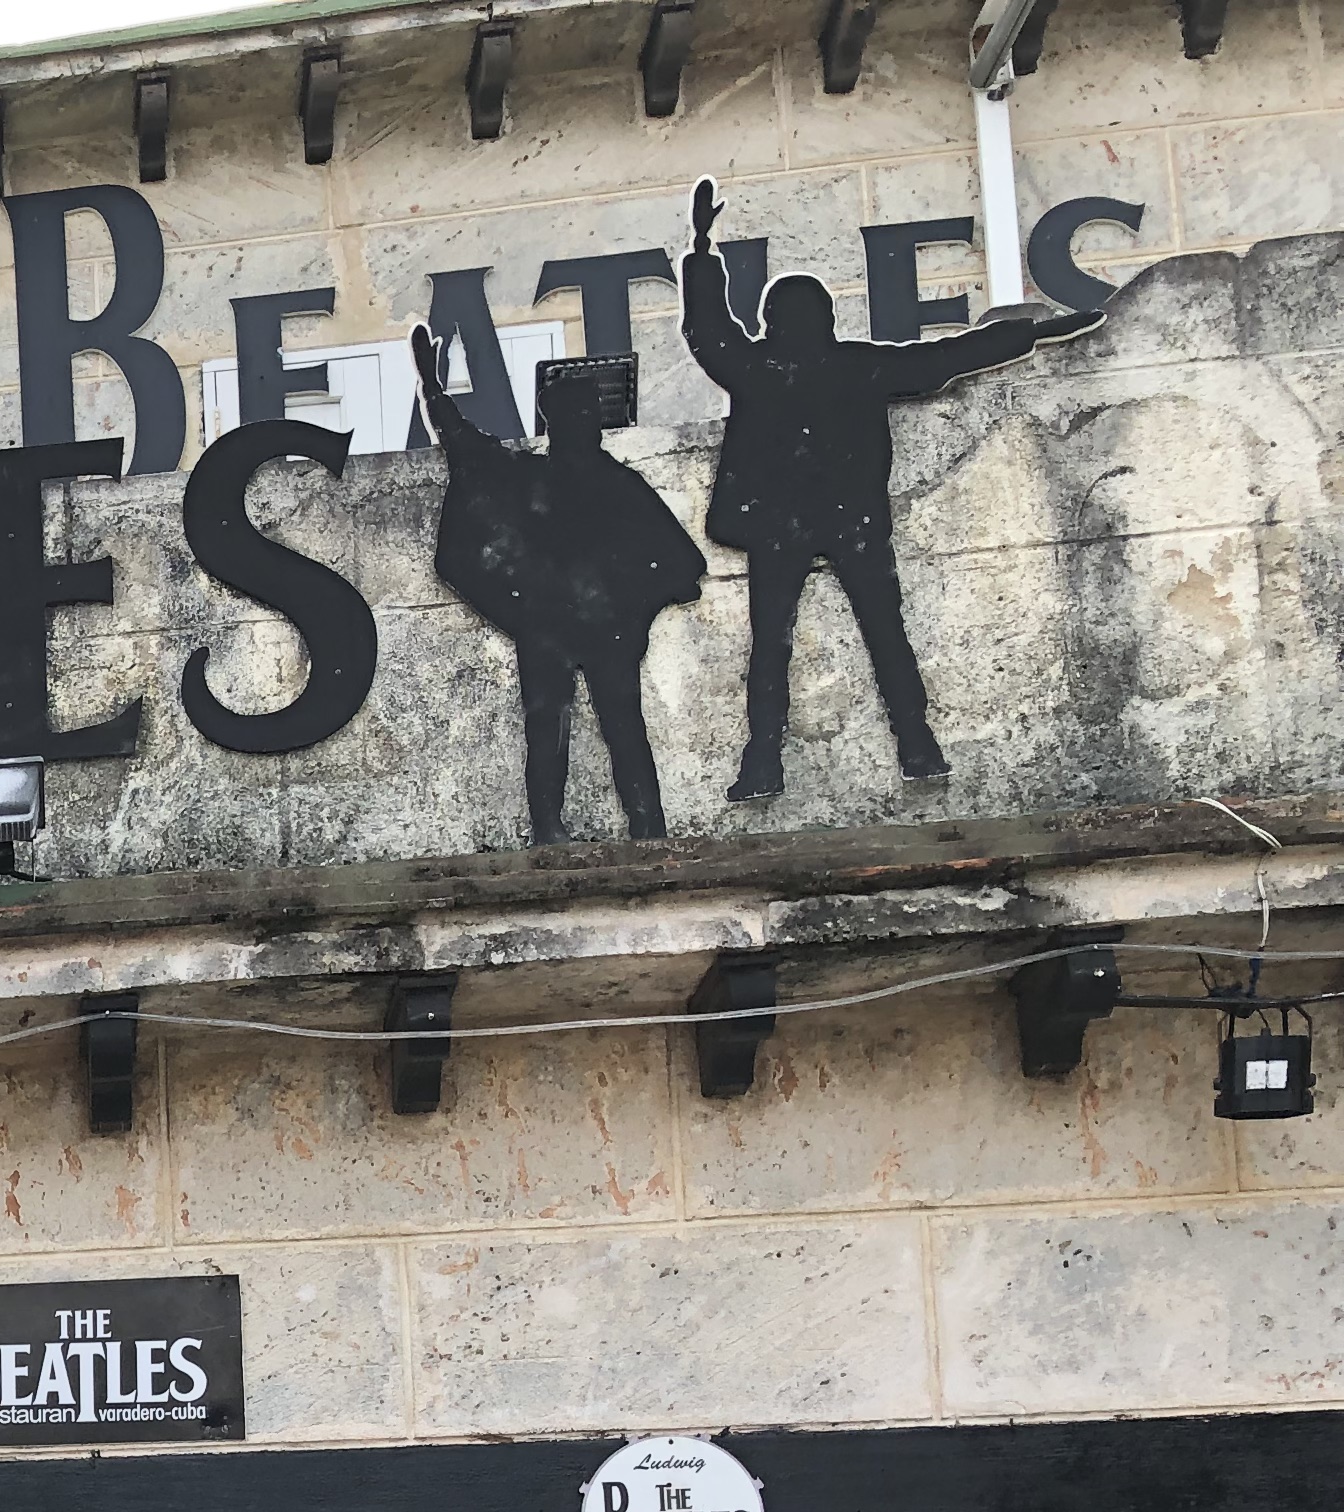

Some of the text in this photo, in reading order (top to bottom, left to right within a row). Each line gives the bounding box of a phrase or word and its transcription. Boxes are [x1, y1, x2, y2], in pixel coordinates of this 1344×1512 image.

[55, 1309, 112, 1340] THE
[98, 1403, 207, 1422] varadero-cuba
[633, 1453, 707, 1474] Ludwig
[655, 1483, 693, 1512] THE
